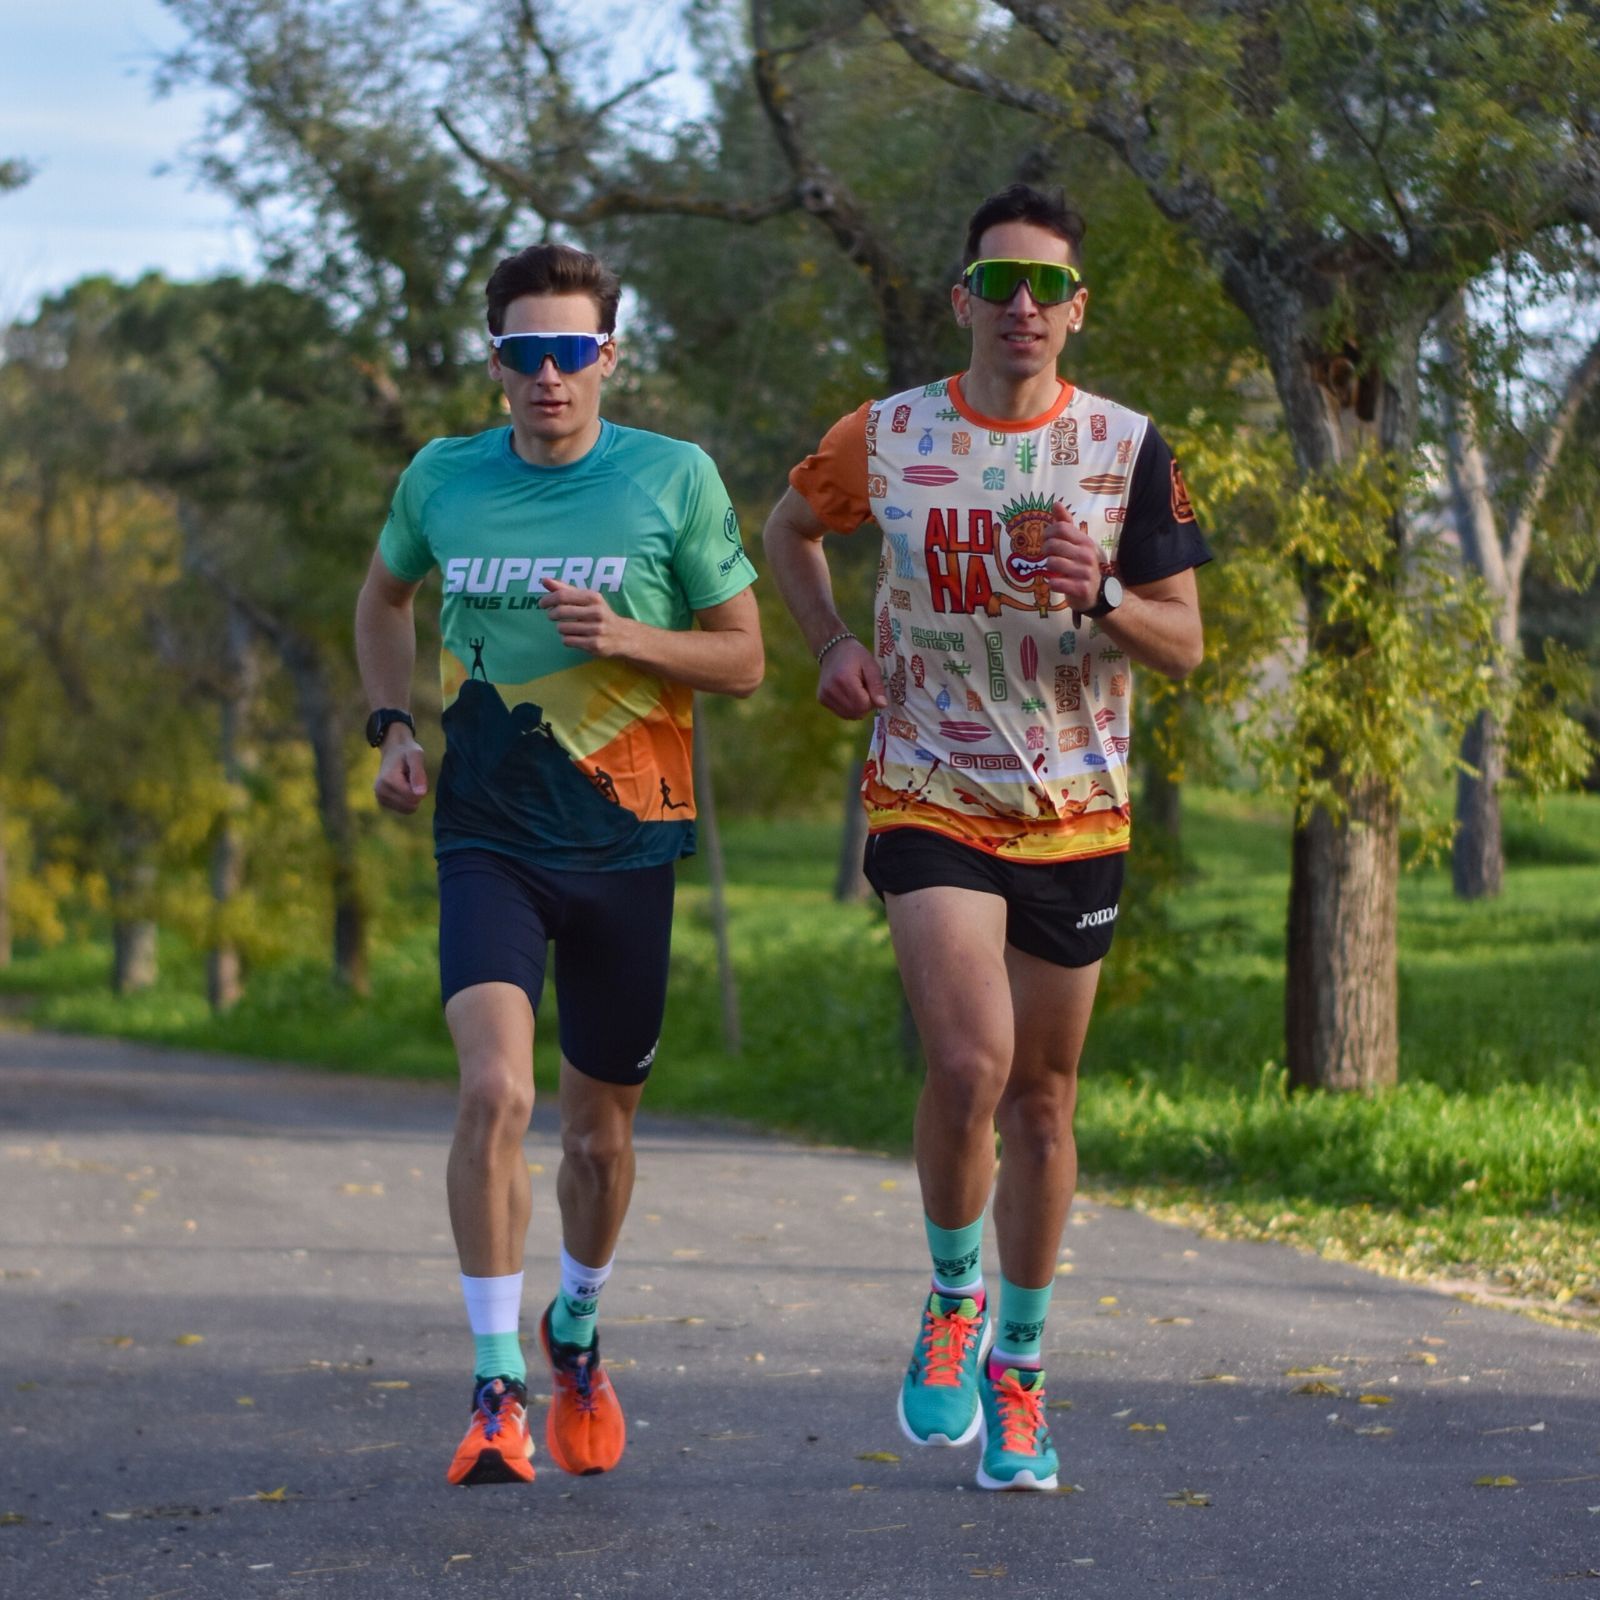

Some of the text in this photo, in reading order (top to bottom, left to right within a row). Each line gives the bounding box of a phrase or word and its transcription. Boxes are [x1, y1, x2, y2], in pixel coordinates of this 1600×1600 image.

[925, 508, 994, 555] ALO
[445, 556, 627, 593] SUPERA
[925, 549, 994, 614] HA
[462, 596, 502, 610] TUS
